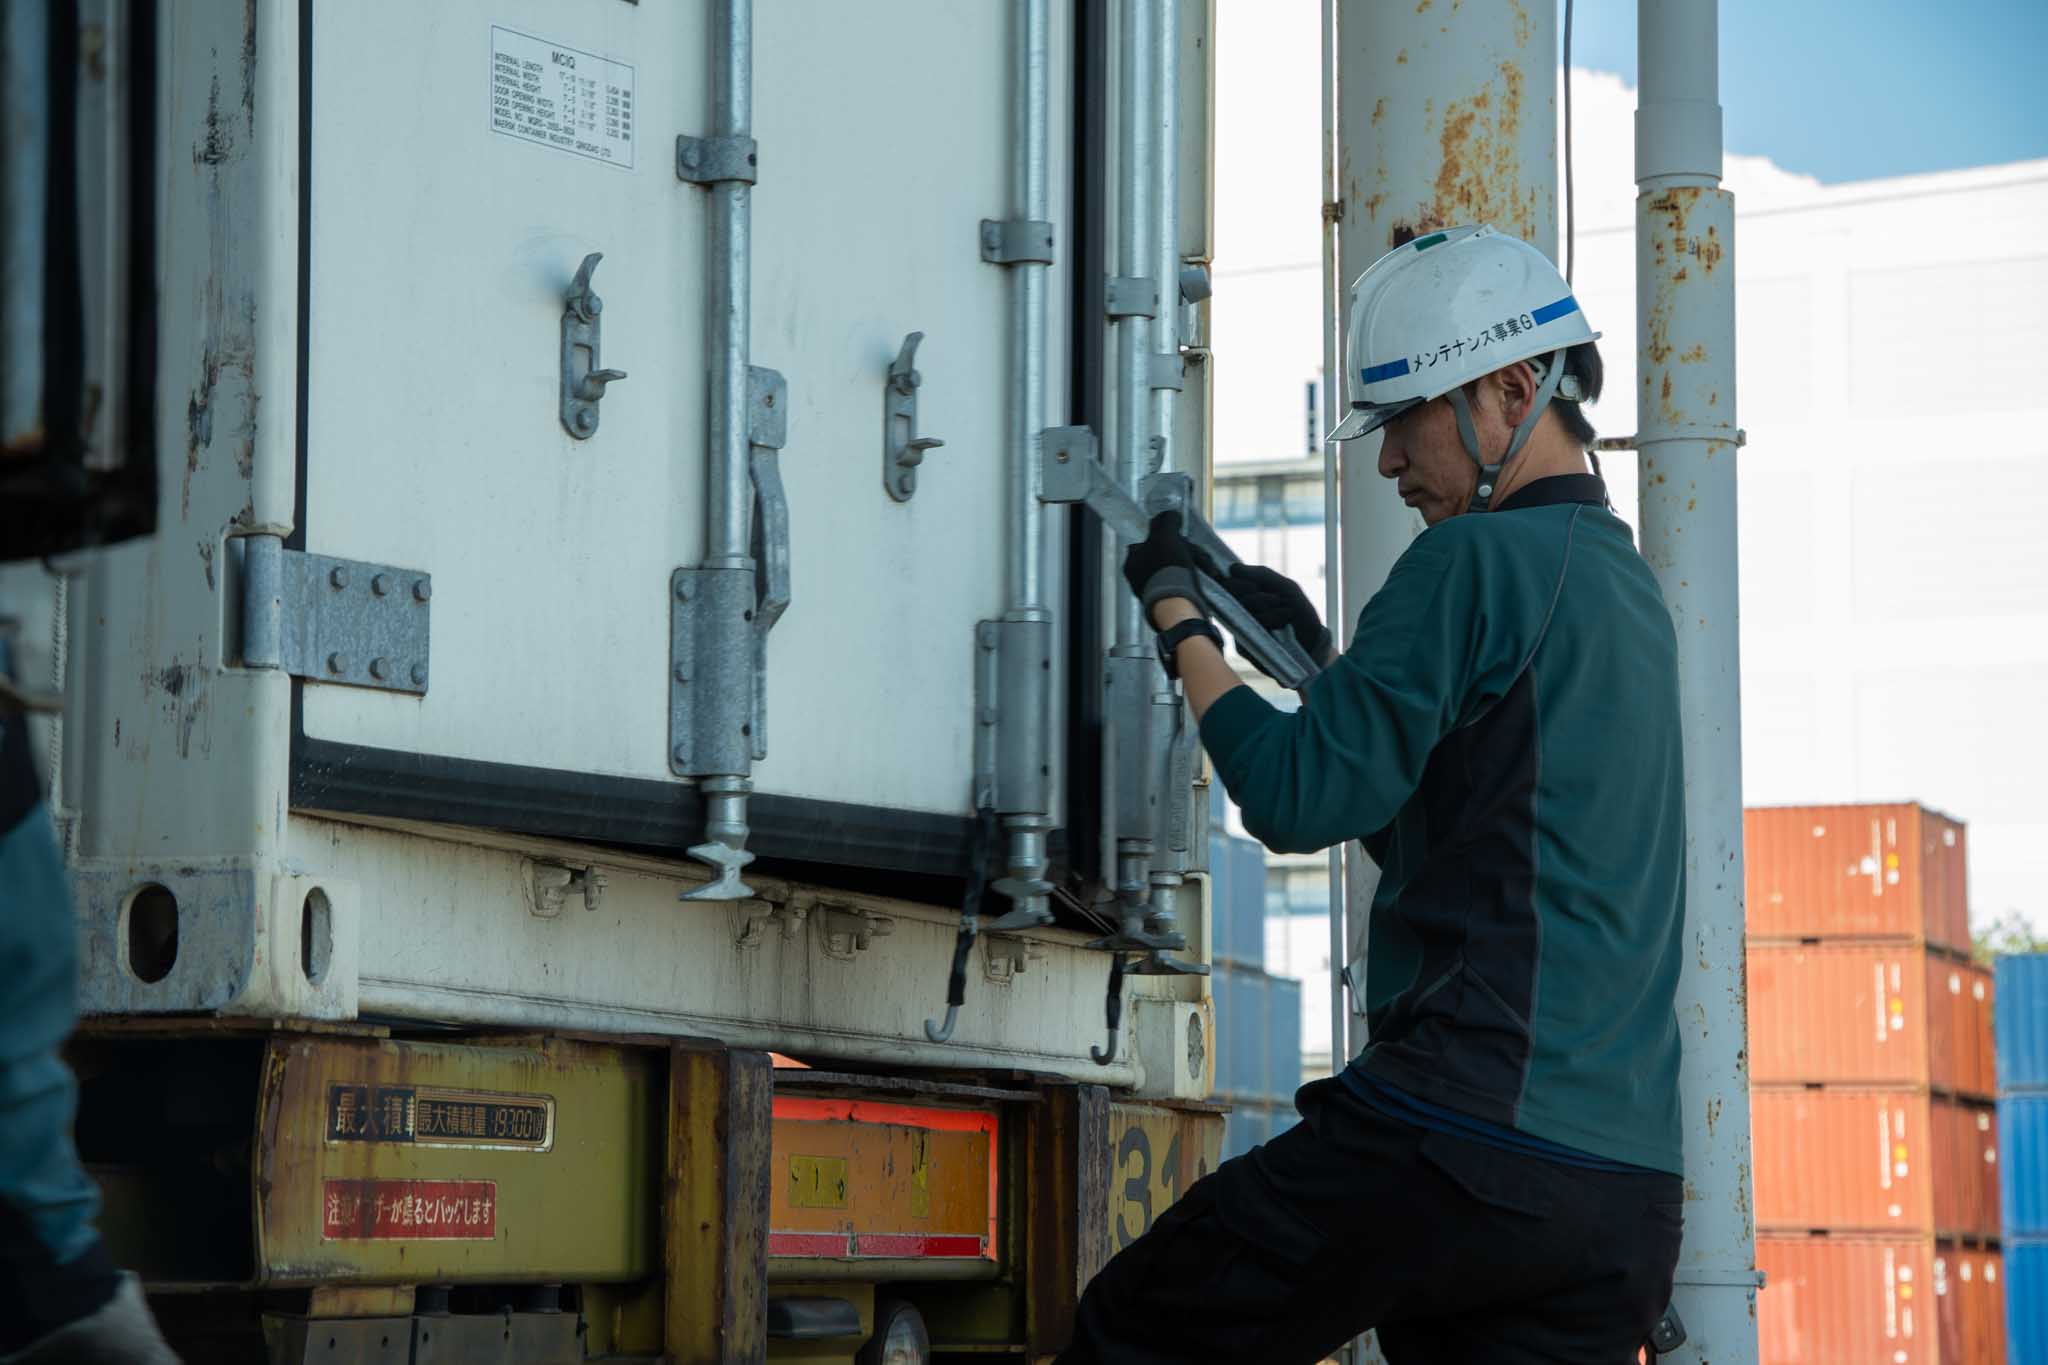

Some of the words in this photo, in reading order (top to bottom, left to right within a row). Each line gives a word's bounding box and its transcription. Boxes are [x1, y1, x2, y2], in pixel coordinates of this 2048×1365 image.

[552, 50, 575, 69] MCIQ
[1413, 313, 1533, 373] メンテナンス事業G
[418, 1103, 486, 1137] 最大積載量
